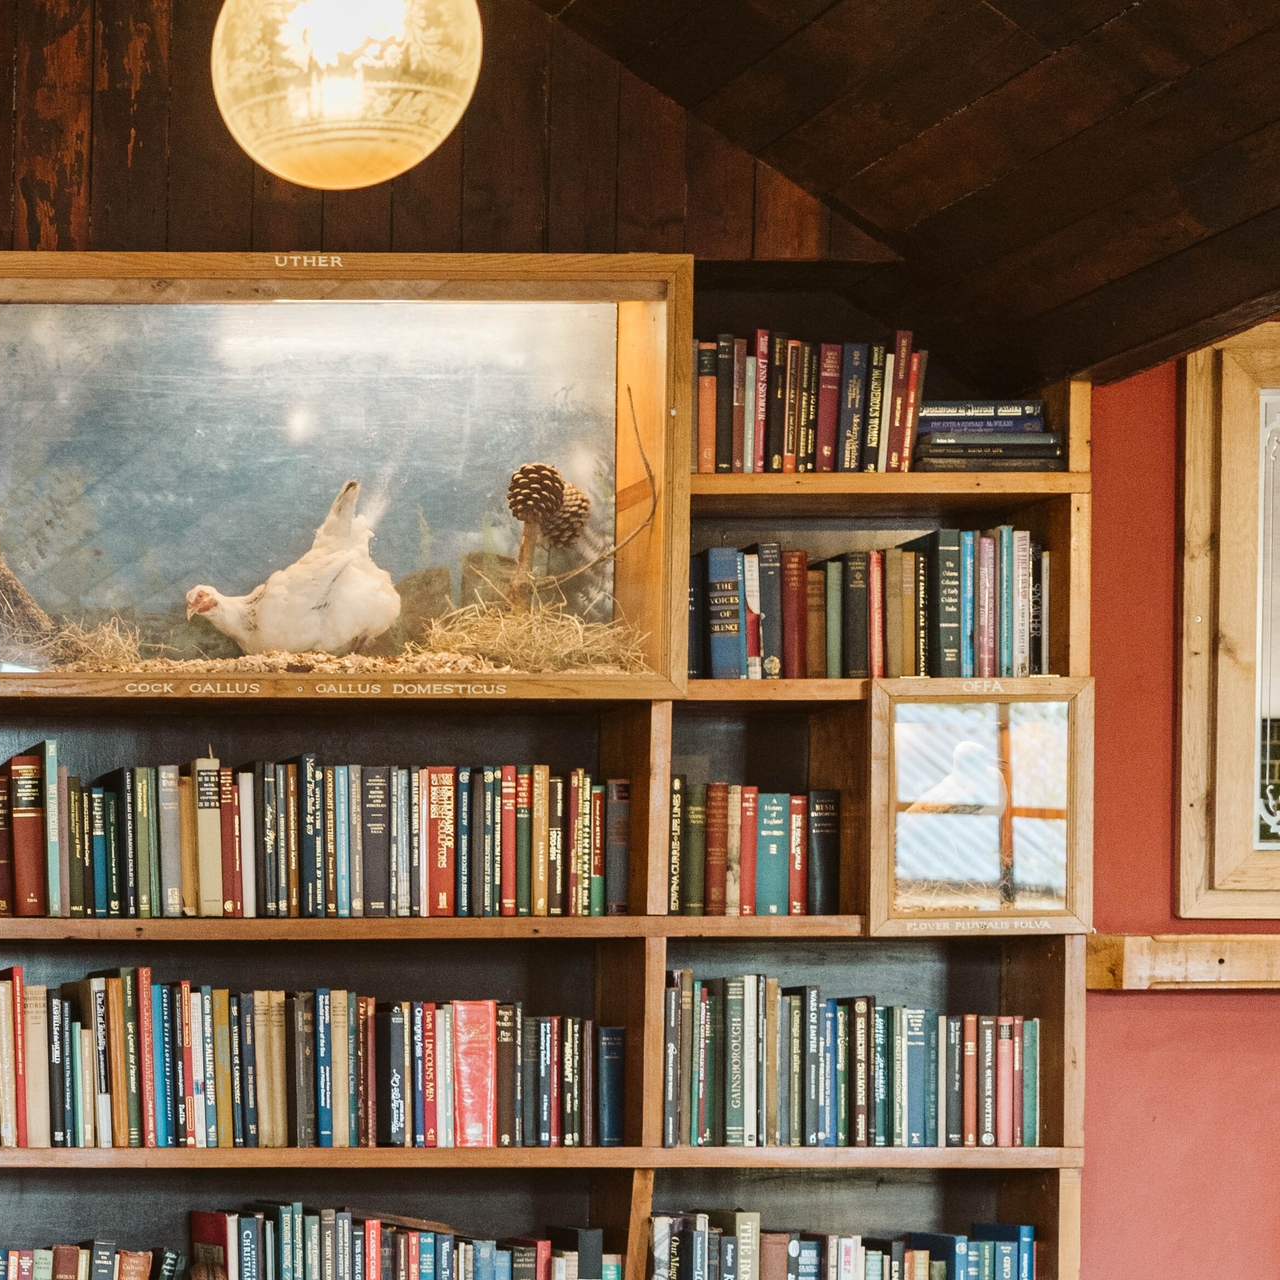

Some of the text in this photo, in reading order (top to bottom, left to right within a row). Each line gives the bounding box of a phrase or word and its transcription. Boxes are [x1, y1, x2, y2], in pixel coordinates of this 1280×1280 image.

[274, 257, 343, 266] UTHER
[1030, 584, 1042, 636] SPYCATCHER
[126, 683, 506, 694] COCK GALLUS GALLUS DOMESTICUS
[963, 681, 1003, 692] OFFA
[907, 922, 950, 930] PLOVER
[1015, 920, 1050, 929] FULVA
[205, 1044, 215, 1105] SAILING SHIPS
[670, 1236, 680, 1254] Our
[739, 1222, 751, 1256] THE
